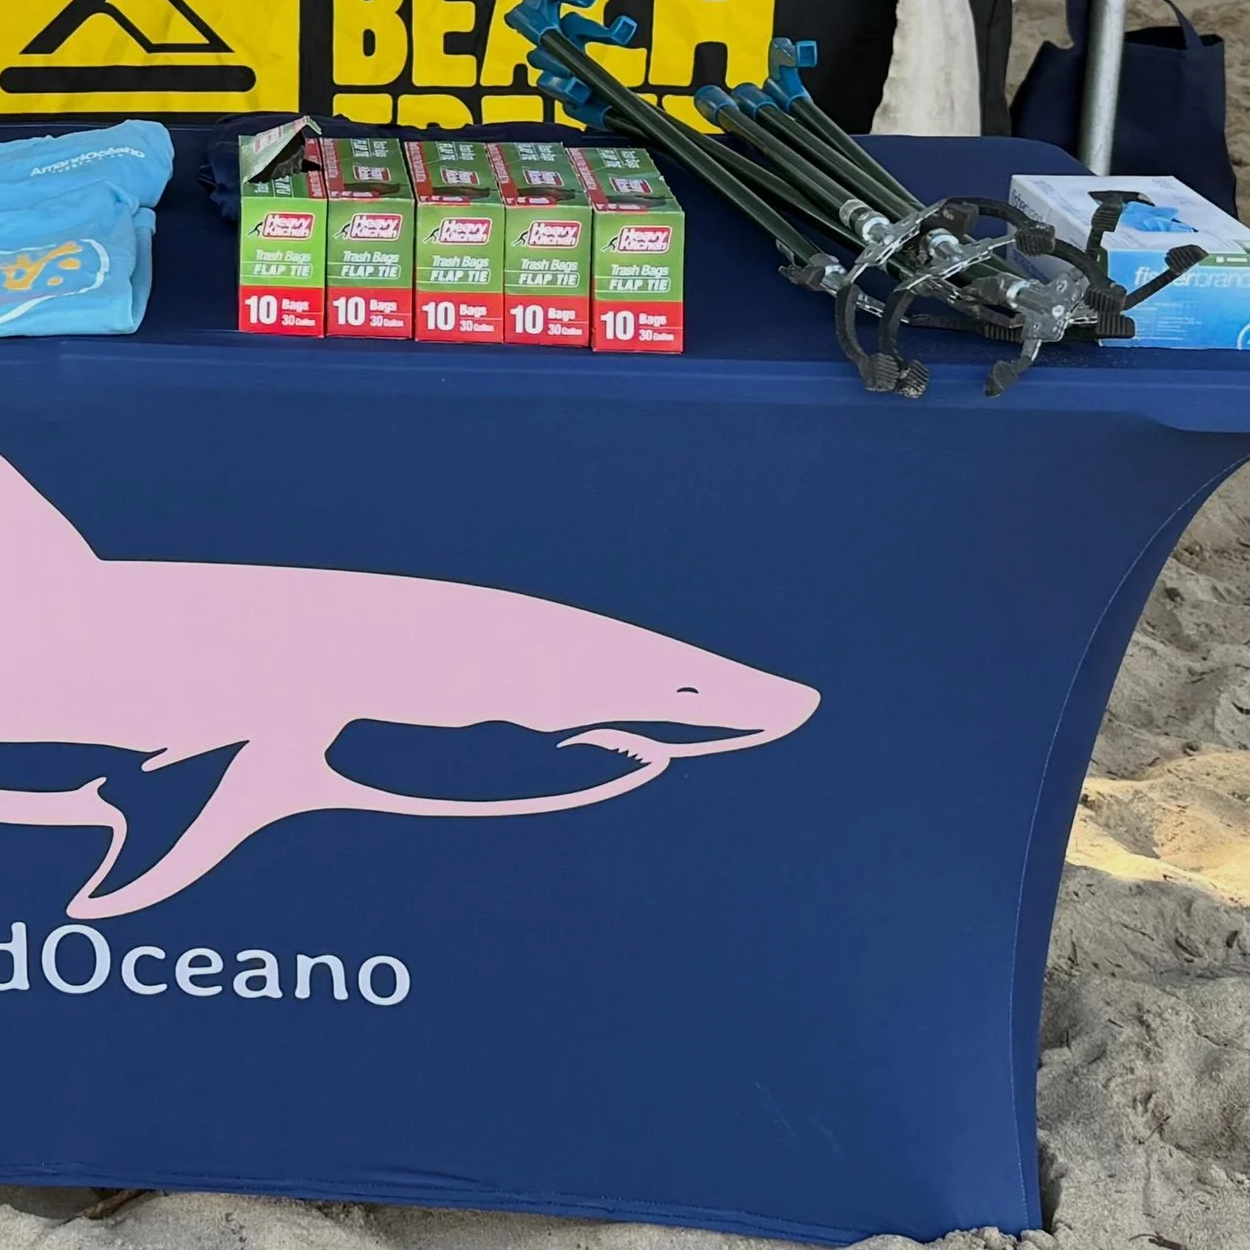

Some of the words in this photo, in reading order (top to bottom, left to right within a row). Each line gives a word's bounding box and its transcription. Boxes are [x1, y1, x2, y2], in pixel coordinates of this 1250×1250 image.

[267, 214, 311, 229] Heavy
[354, 214, 399, 229] Heavy
[444, 220, 488, 234] Heavy
[533, 223, 576, 236] Heavy
[623, 228, 669, 241] Heavy
[256, 250, 283, 261] Trash
[285, 251, 311, 263] Bags
[343, 251, 370, 262] Trash
[372, 251, 399, 264] Bags
[433, 255, 460, 267] Trash
[462, 256, 489, 269] Bags
[253, 264, 286, 275] FLAP
[290, 265, 311, 276] TIE
[341, 265, 374, 277] FLAP
[378, 266, 398, 278] TIE
[521, 259, 548, 270] Trash
[550, 260, 578, 272] Bags
[612, 264, 639, 276] Trash
[641, 265, 669, 278] Bags
[430, 270, 464, 282] FLAP
[468, 271, 488, 282] TIE
[519, 273, 552, 285] FLAP
[556, 273, 576, 285] TIE
[609, 278, 643, 290] FLAP
[647, 279, 667, 291] TIE
[245, 295, 277, 325] 10
[282, 299, 309, 312] Bags
[333, 296, 365, 326] 10
[370, 299, 397, 312] Bags
[422, 301, 455, 331] 10
[460, 304, 487, 318] Bags
[282, 315, 295, 326] 30
[370, 315, 383, 327] 30
[510, 305, 543, 334] 10
[548, 307, 576, 321] Bags
[601, 311, 634, 340] 10
[639, 313, 667, 326] Bags
[460, 321, 473, 332] 30
[548, 324, 562, 335] 30
[639, 329, 652, 341] 30
